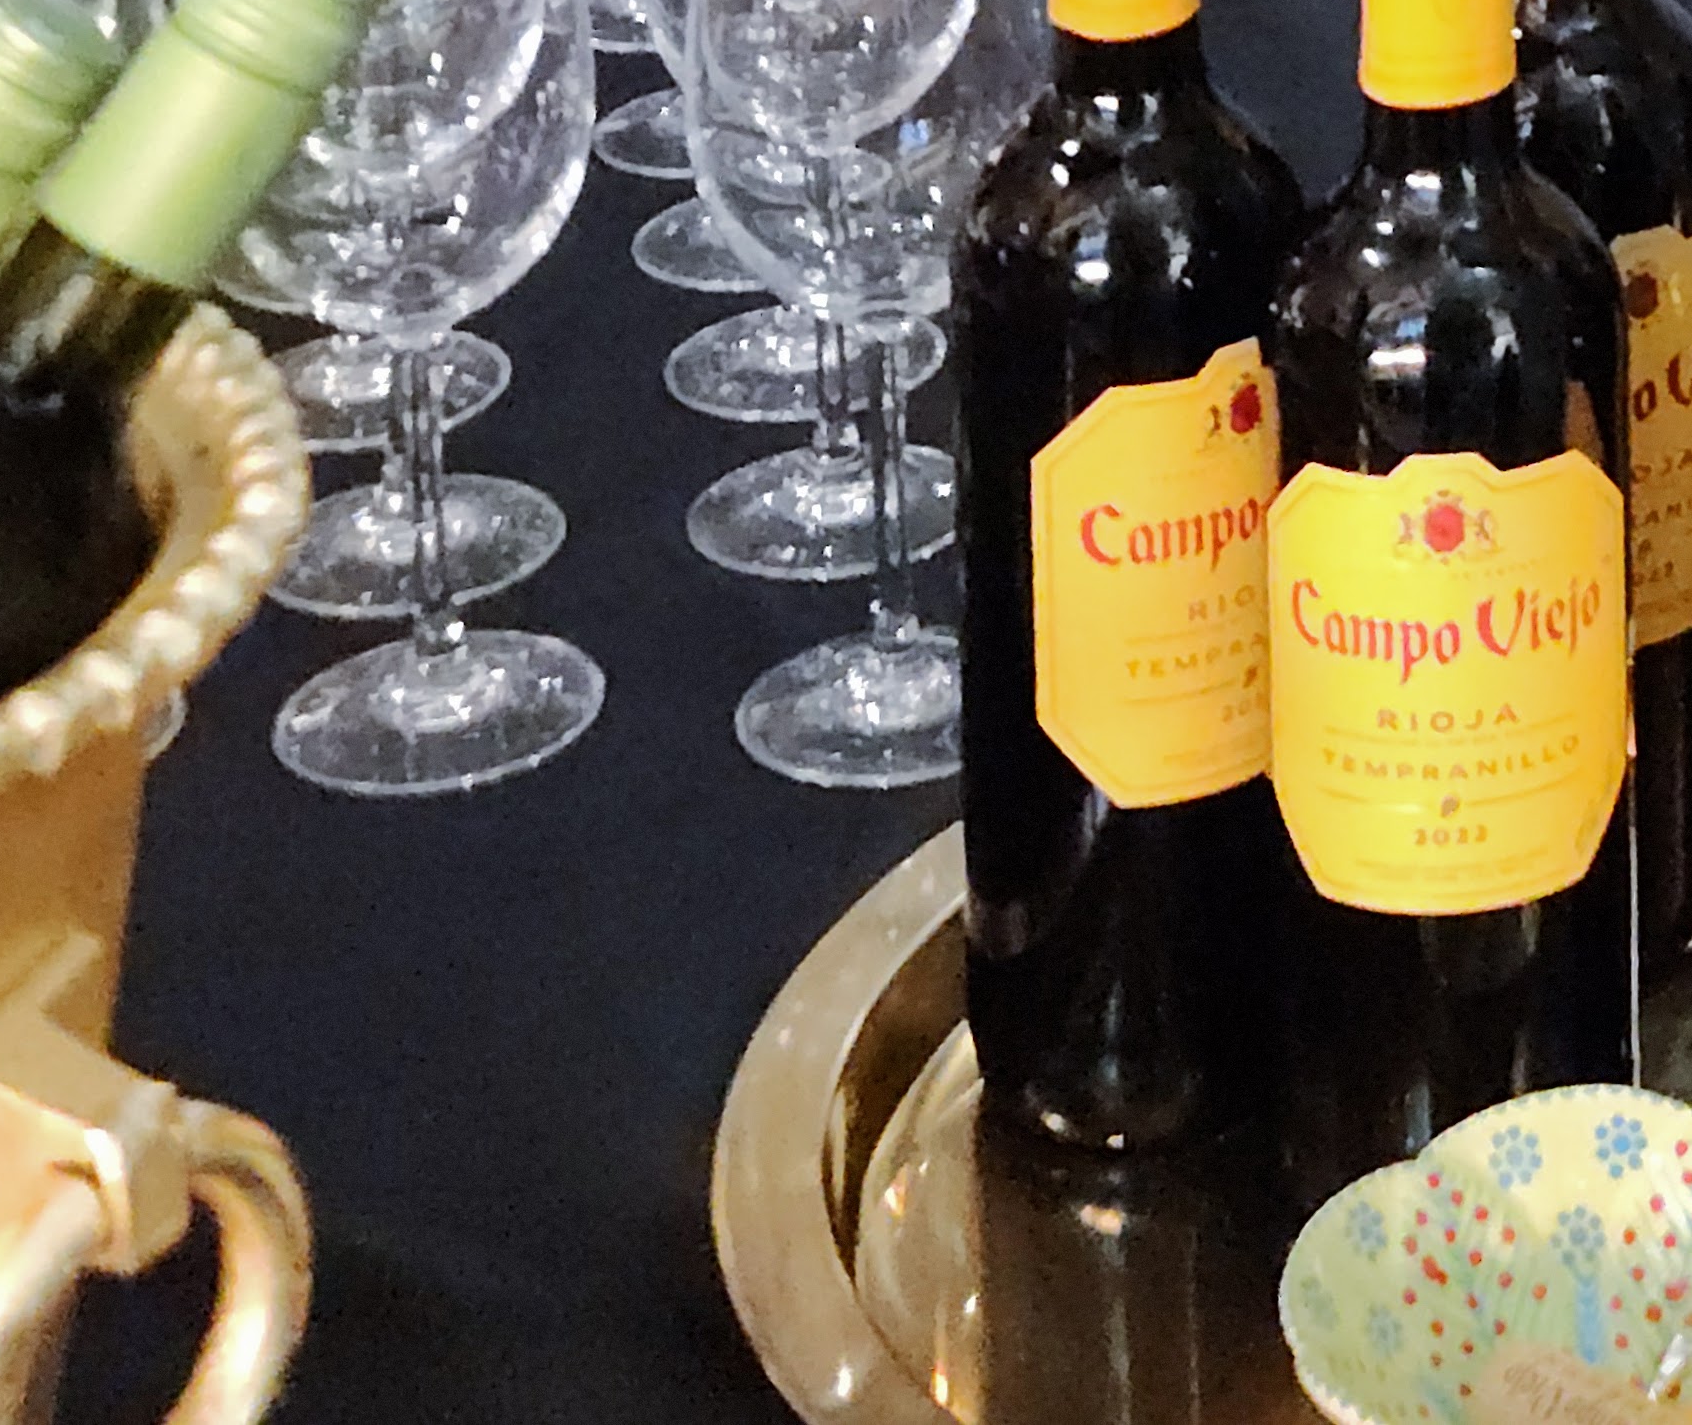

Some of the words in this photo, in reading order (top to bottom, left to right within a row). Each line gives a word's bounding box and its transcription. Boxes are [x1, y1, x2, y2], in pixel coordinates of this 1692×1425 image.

[1079, 496, 1259, 573] Campo
[1186, 583, 1257, 622] RIO
[1291, 578, 1461, 686] Campo
[1476, 576, 1602, 659] Viejo
[1376, 703, 1522, 734] RIOJA
[1322, 735, 1580, 781] TEMPRANILLO
[1413, 824, 1490, 847] 2022
